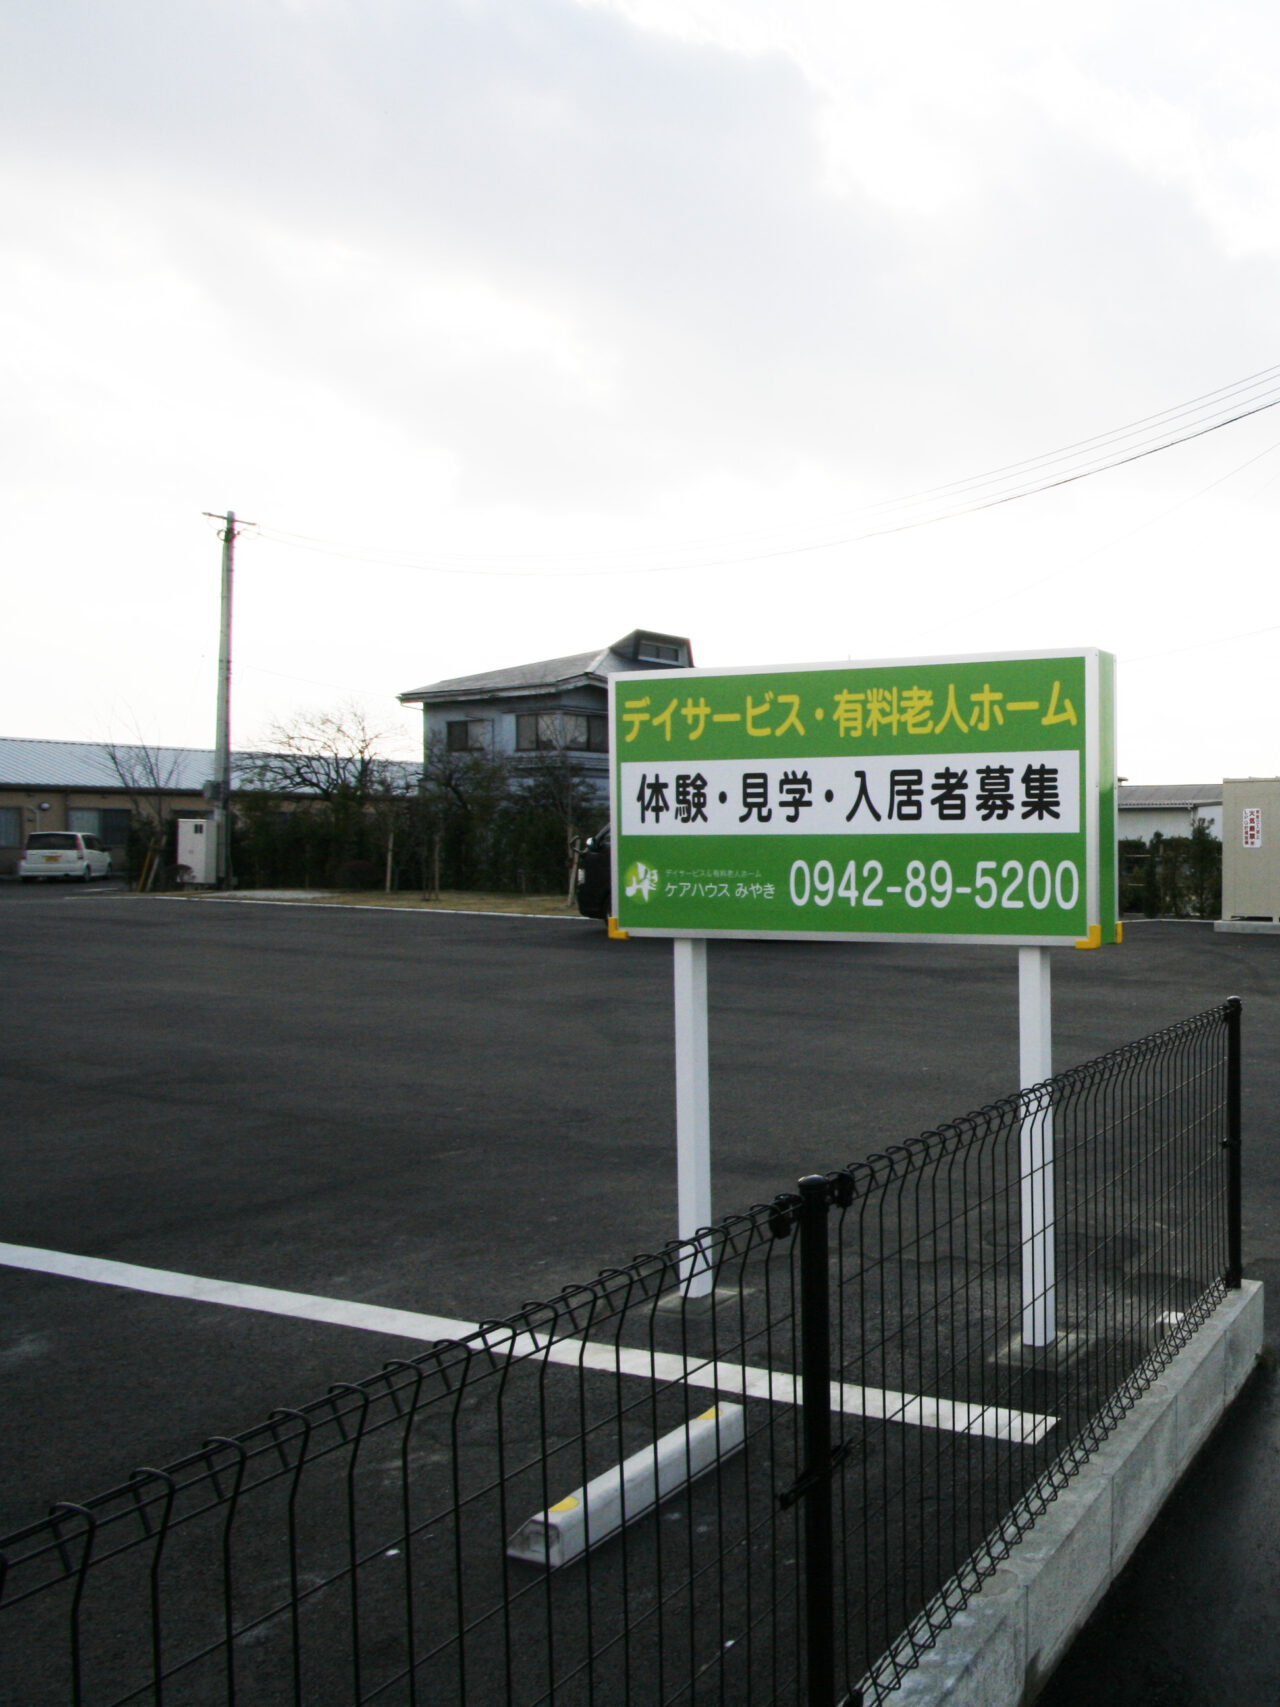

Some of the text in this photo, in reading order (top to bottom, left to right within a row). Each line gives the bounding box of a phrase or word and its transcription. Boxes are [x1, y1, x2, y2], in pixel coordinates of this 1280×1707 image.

[622, 680, 1078, 743] デイサービス・有料老人ホーム
[636, 763, 1061, 824] 体験・見学・入居者募集
[665, 882, 776, 900] ケアハウス みやき
[789, 859, 1080, 911] 0942-89-5200
